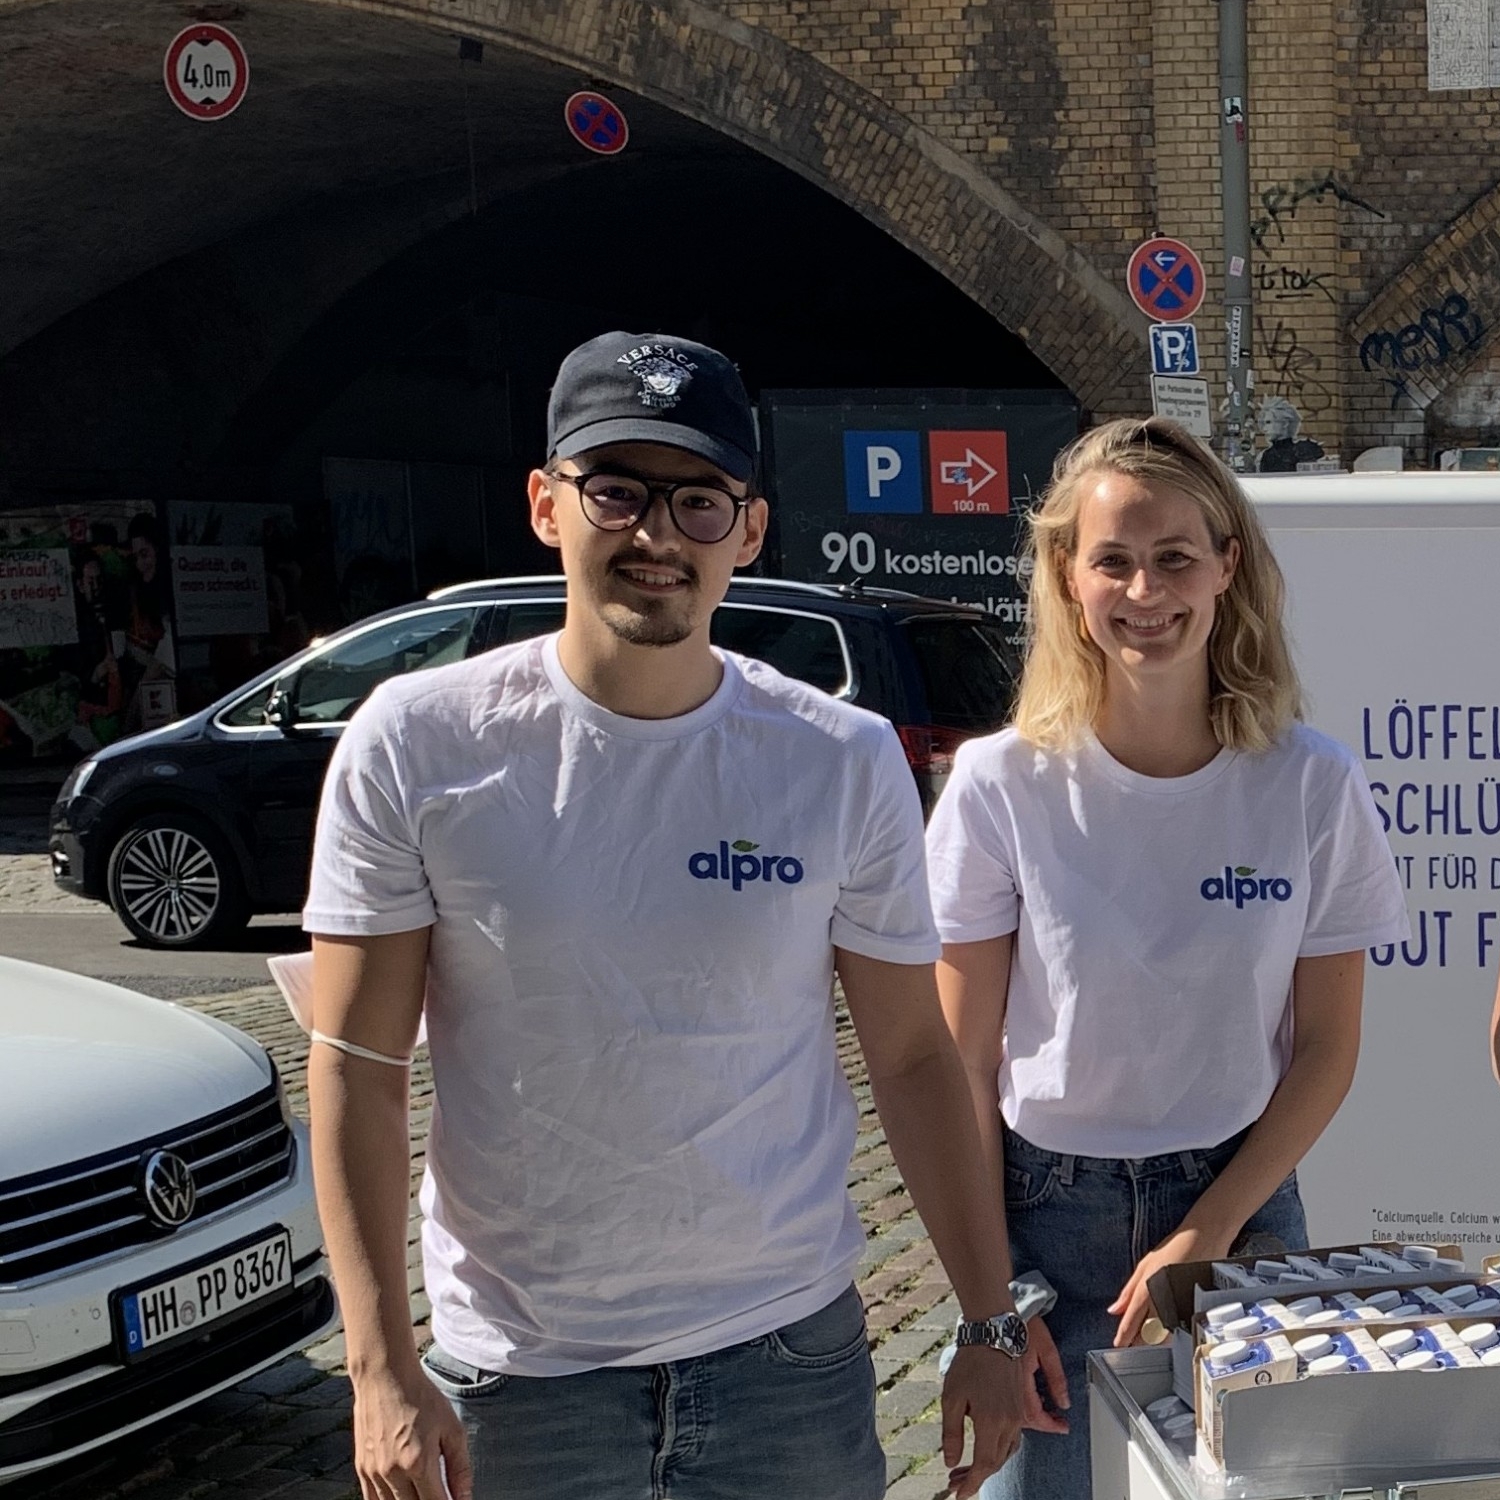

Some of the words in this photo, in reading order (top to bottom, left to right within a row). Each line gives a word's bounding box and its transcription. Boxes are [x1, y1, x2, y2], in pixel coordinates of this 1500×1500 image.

[617, 344, 699, 372] VERSACE
[867, 446, 901, 497] P
[953, 500, 974, 512] 100
[977, 502, 990, 512] m
[822, 532, 876, 574] 90
[688, 840, 804, 891] alpro
[1429, 854, 1477, 890] FÜR
[1201, 866, 1292, 909] alpro
[1372, 1229, 1392, 1242] Eine
[1450, 1211, 1488, 1224] Calcium
[141, 1286, 179, 1341] HH
[197, 1267, 227, 1318] PP
[233, 1240, 286, 1300] 8367
